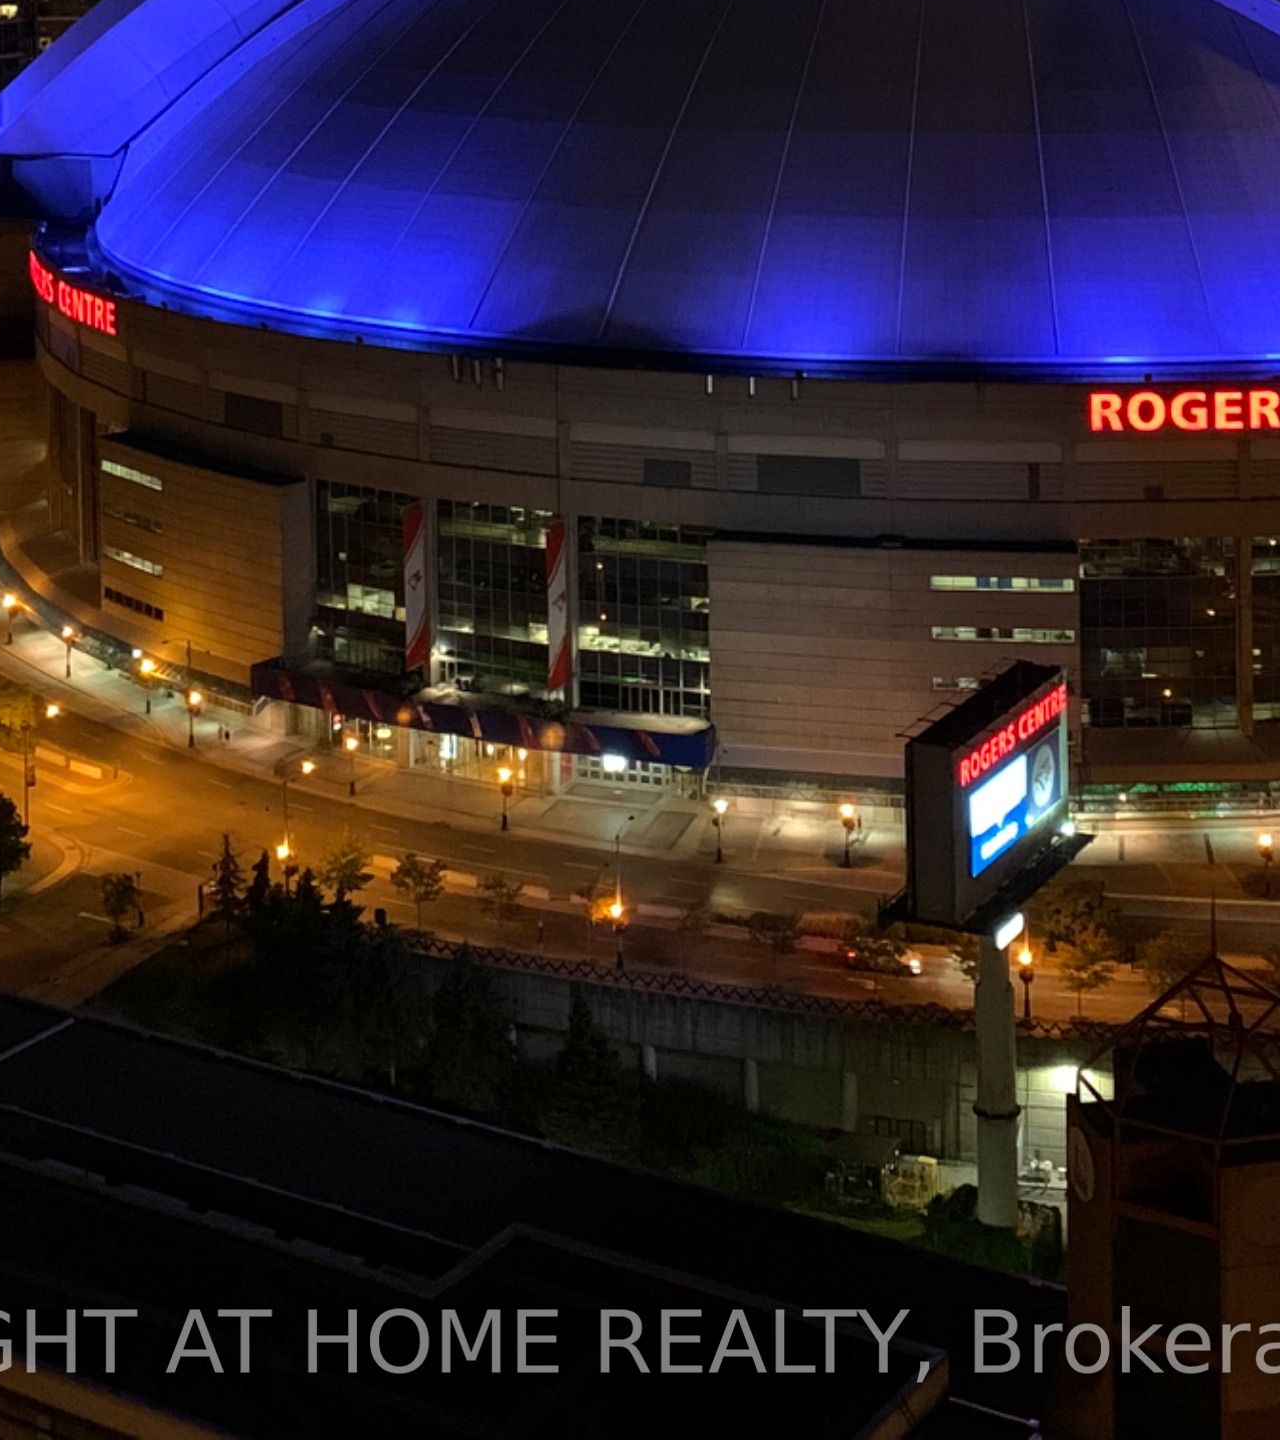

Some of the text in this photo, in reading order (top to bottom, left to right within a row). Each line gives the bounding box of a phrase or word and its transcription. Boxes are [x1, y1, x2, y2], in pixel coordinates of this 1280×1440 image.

[58, 279, 116, 336] CENTRE
[960, 683, 1067, 788] ROGERS CENTRE
